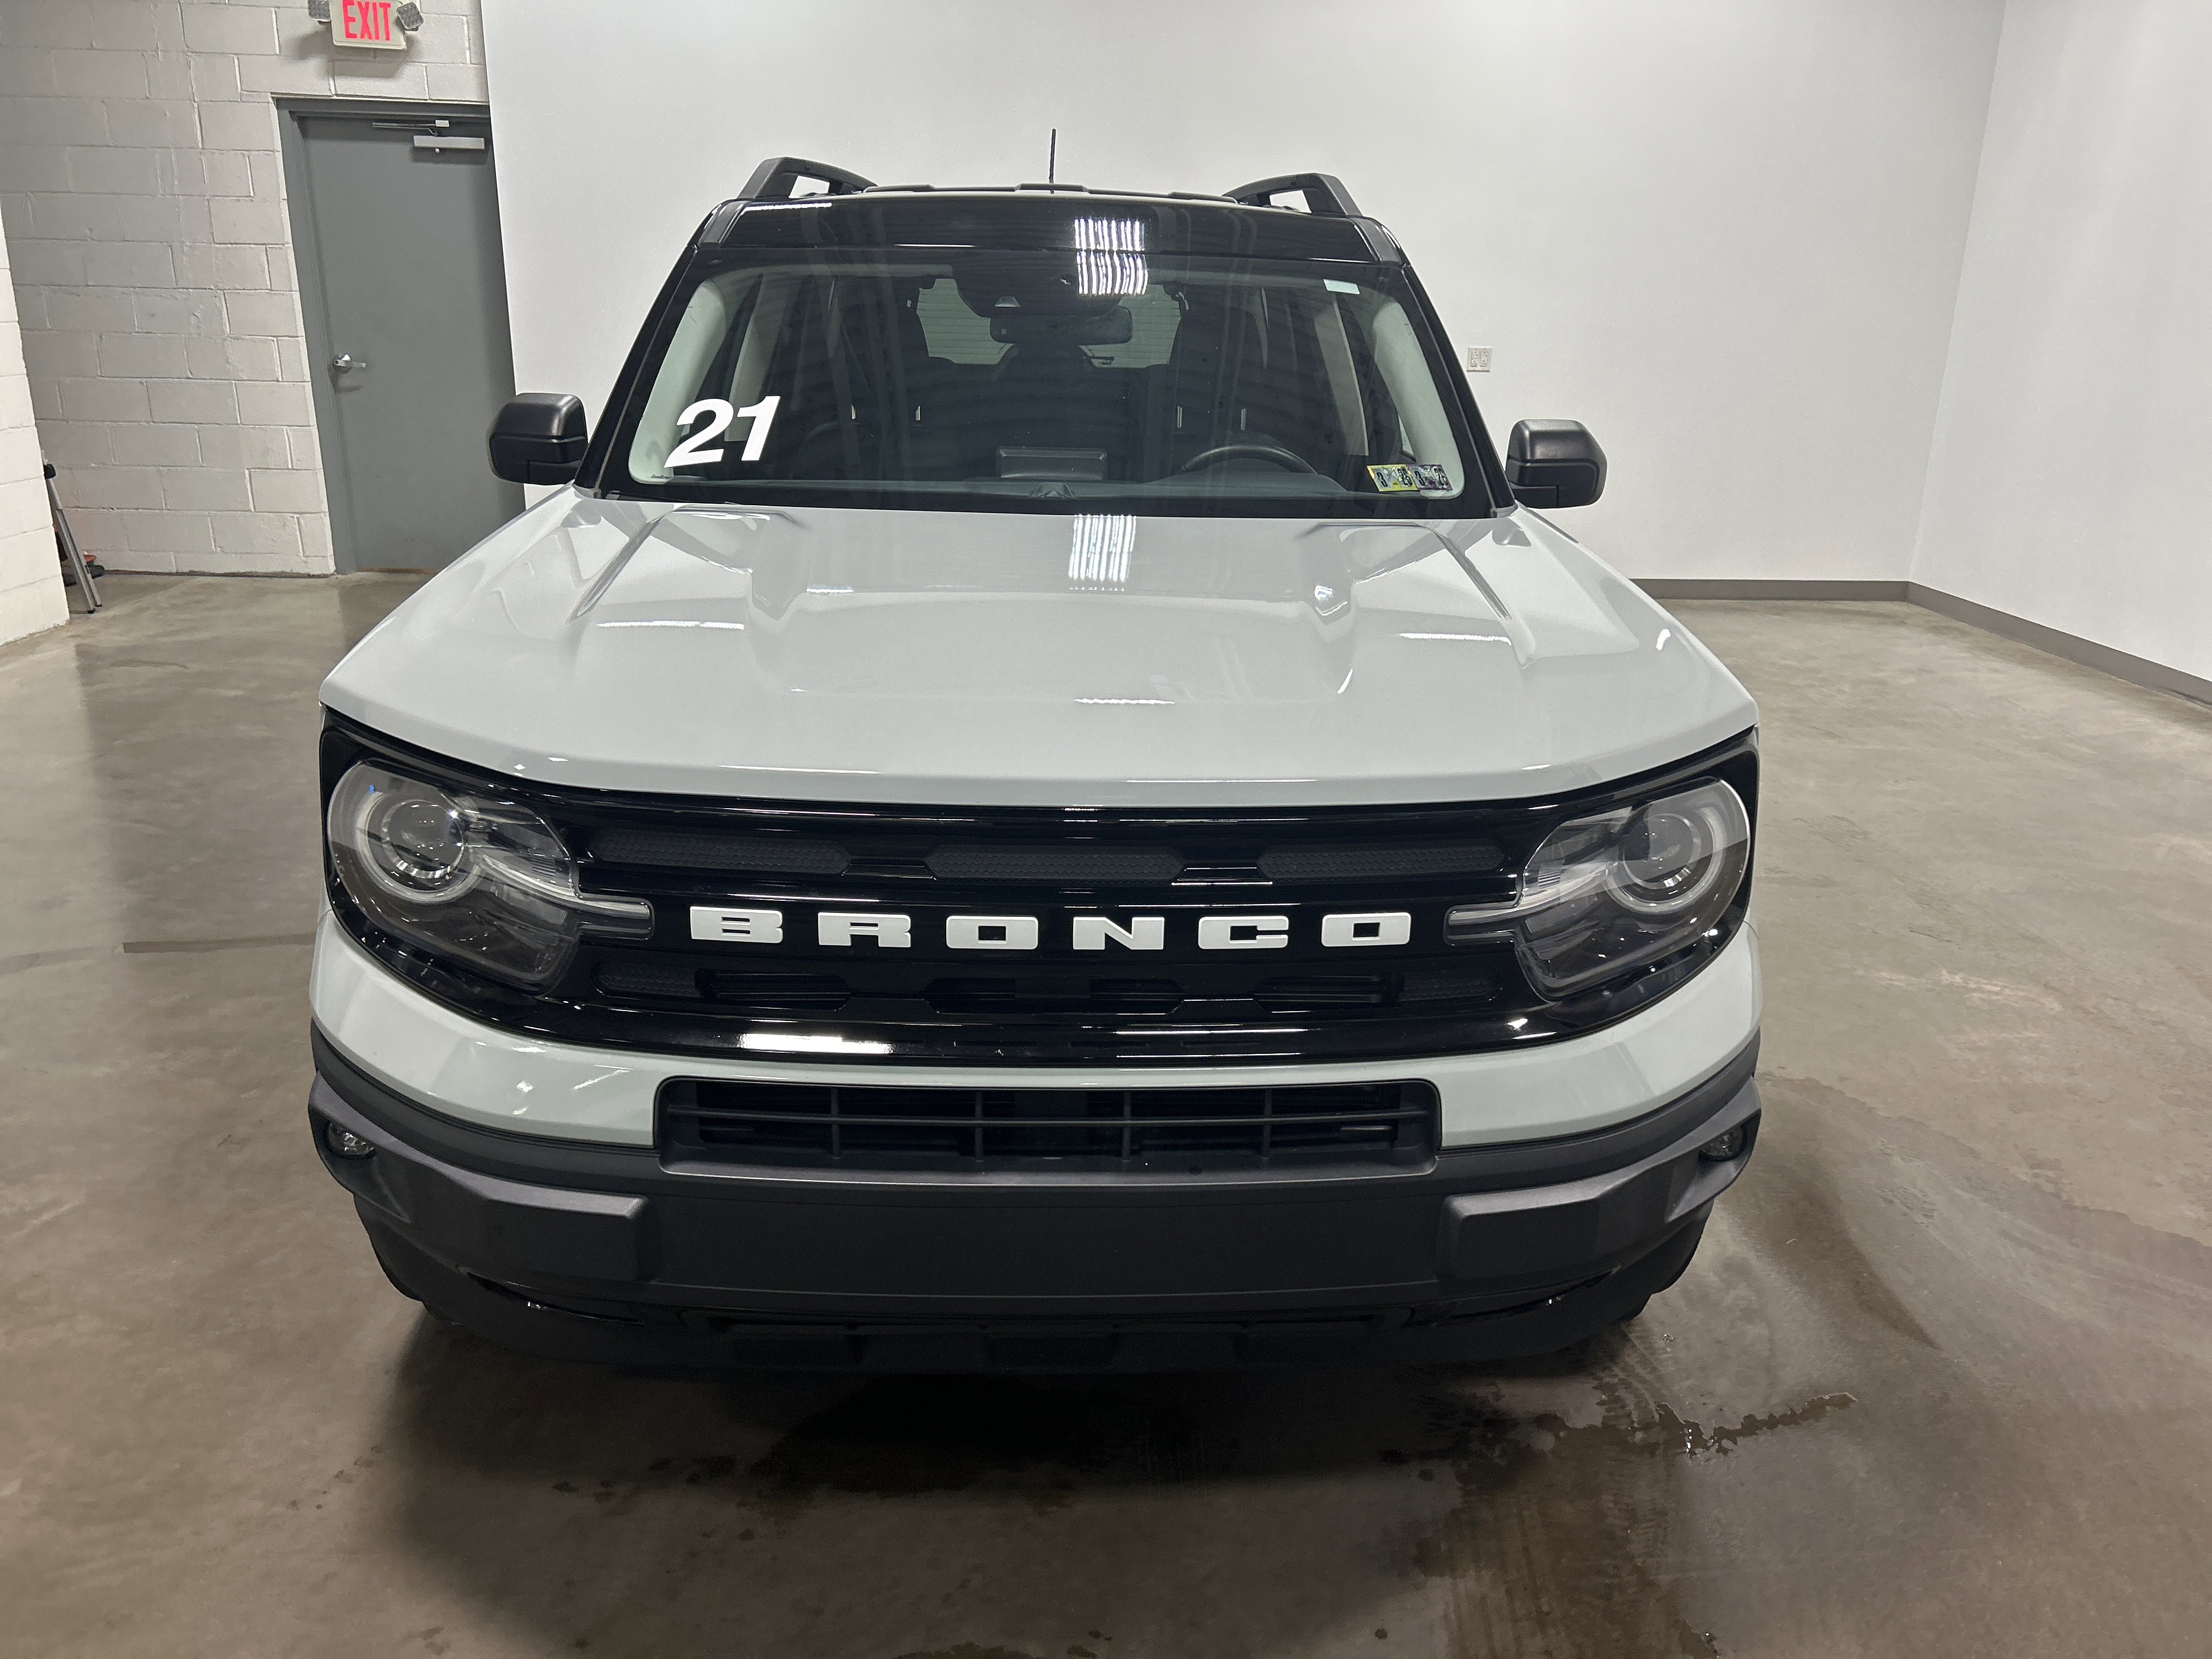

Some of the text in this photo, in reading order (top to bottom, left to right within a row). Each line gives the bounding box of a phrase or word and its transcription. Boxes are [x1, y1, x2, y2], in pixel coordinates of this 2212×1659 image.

[342, 0, 391, 41] EXIT
[664, 396, 781, 468] 21
[690, 906, 1412, 951] BRONCO
